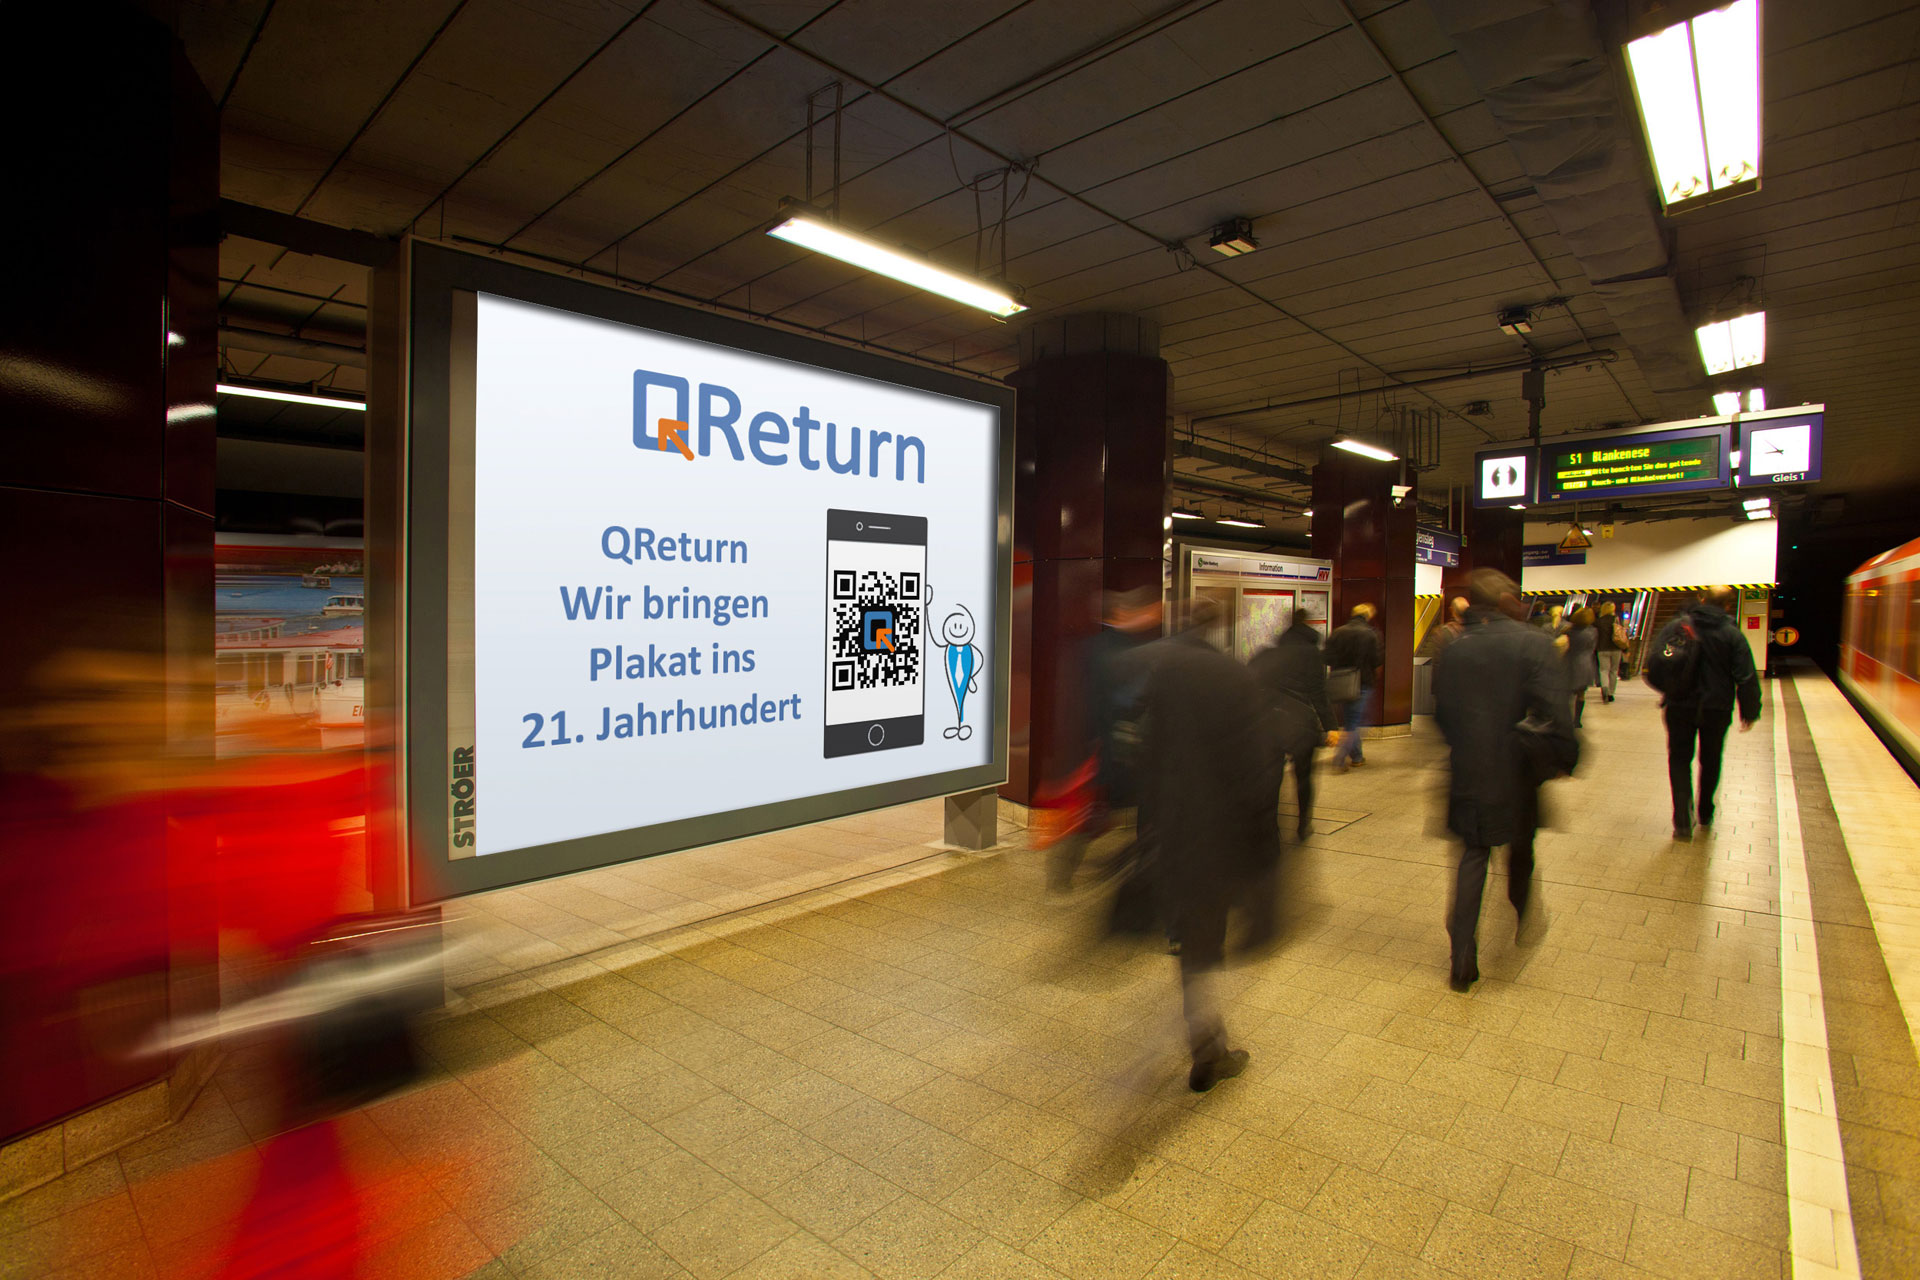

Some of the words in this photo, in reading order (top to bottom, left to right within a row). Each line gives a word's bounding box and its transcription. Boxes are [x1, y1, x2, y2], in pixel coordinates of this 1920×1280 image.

[633, 369, 926, 484] QReturn
[1569, 453, 1582, 465] S1
[1592, 448, 1650, 463] Blankenese
[1772, 474, 1798, 483] Gleis
[1800, 472, 1806, 481] 1
[602, 525, 748, 565] QReturn
[1258, 562, 1284, 573] Information
[560, 586, 632, 621] Wir
[643, 586, 769, 627] bringen
[590, 643, 702, 682] Plakat
[712, 642, 756, 674] ins
[522, 710, 584, 749] 21.
[596, 693, 802, 742] Jahrhundert
[452, 745, 475, 848] STRÖER
